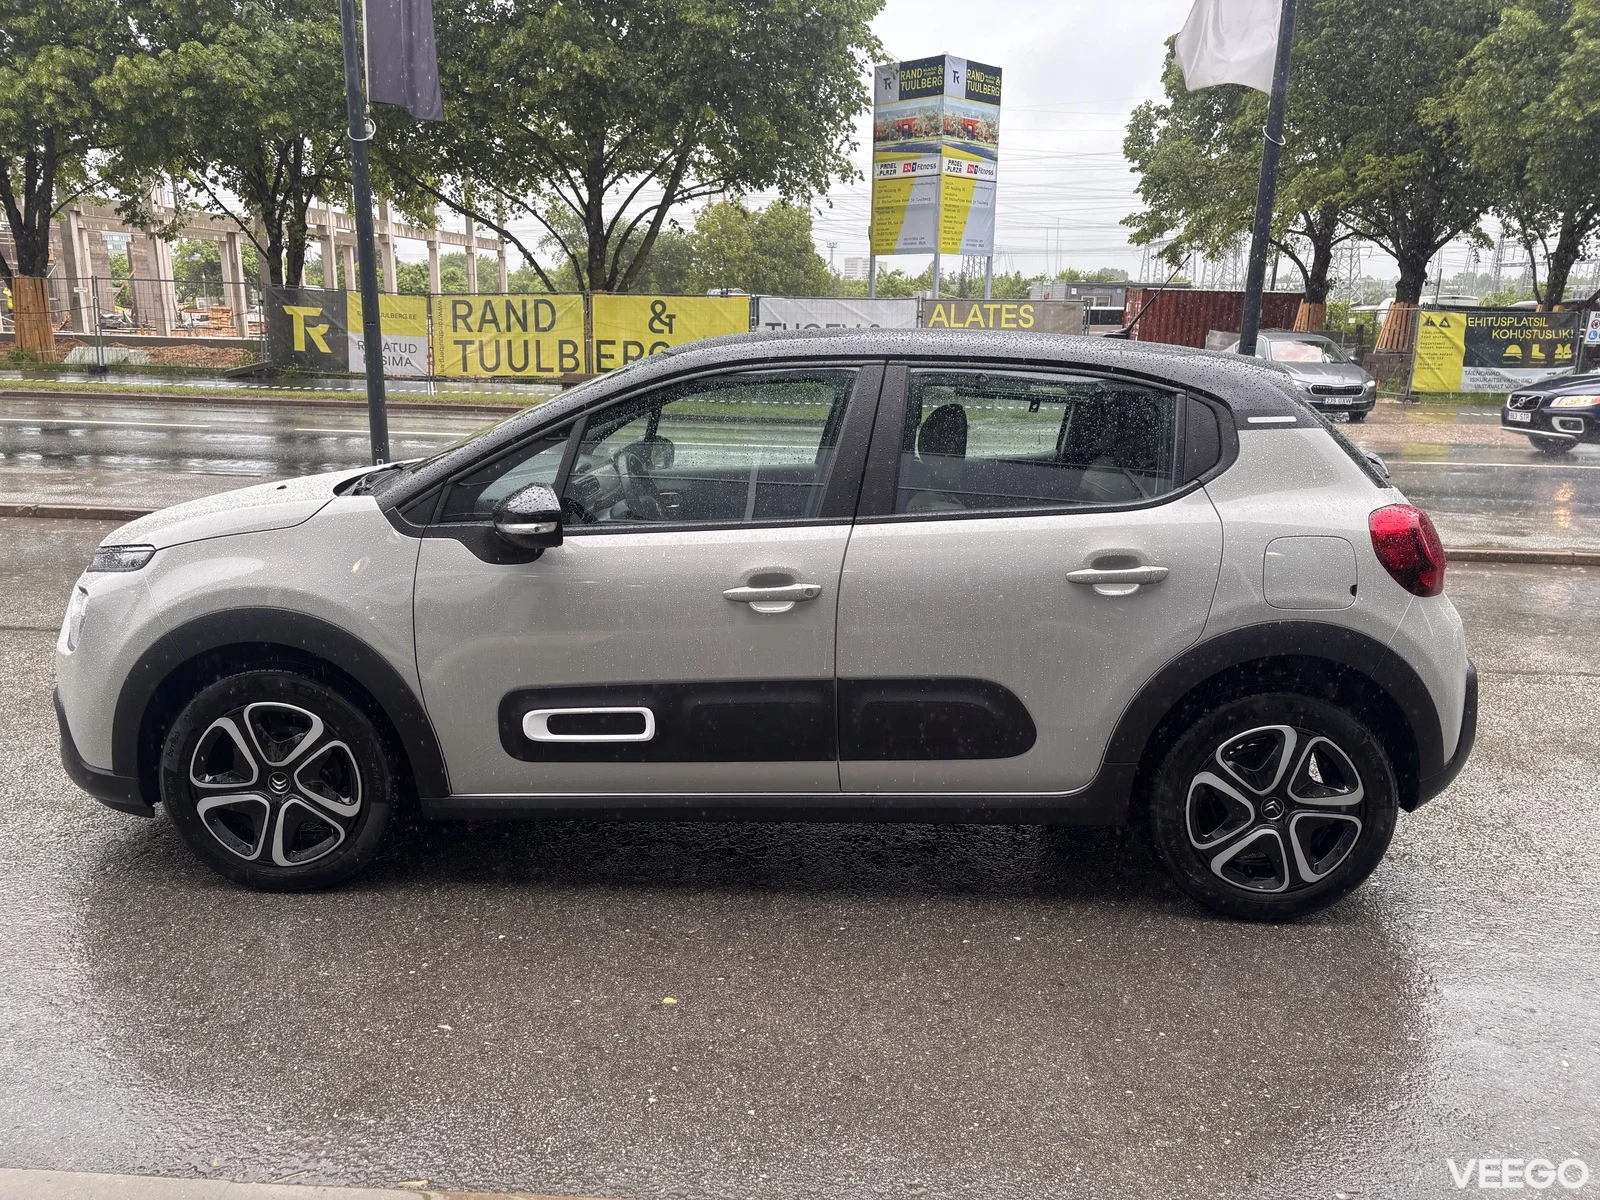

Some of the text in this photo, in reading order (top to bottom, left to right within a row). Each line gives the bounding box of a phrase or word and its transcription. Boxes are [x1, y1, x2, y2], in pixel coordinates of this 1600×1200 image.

[900, 67, 923, 81] RAND
[966, 68, 985, 83] RAND
[900, 75, 943, 92] TUULBERG
[966, 79, 1000, 97] TUULBERG
[451, 299, 677, 335] RAND &
[928, 303, 1035, 329] ALATES
[1468, 316, 1549, 328] EHITUSPLATSIL
[1491, 328, 1575, 340] KOHUSTUSLIK!
